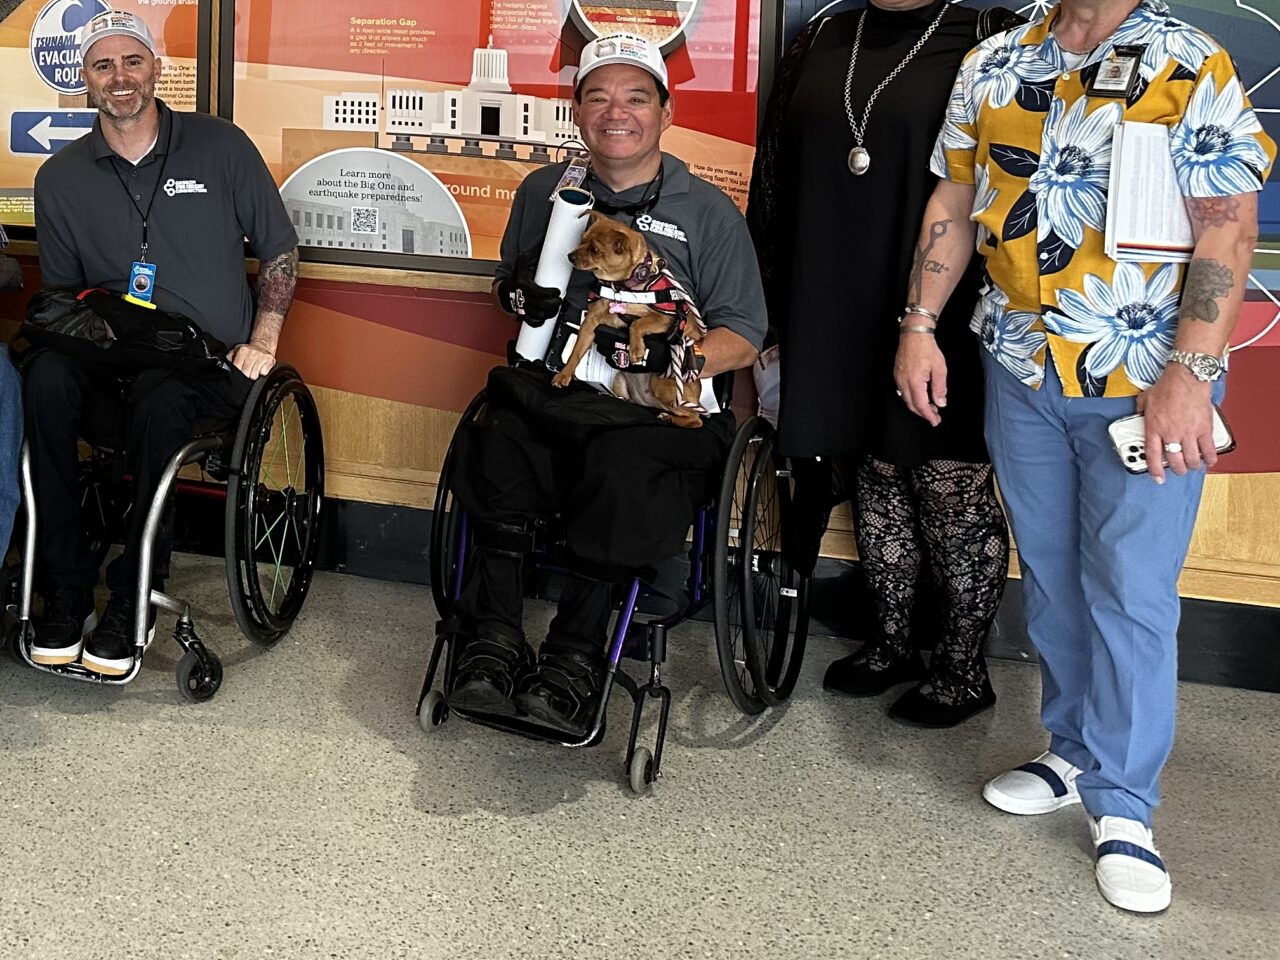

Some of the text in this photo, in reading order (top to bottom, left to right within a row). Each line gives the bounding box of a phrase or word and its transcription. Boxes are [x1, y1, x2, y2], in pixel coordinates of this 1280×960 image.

[350, 17, 416, 27] Separation Gap
[36, 35, 76, 47] TSUNAMI
[39, 49, 82, 65] EVACUA
[54, 67, 83, 82] ROU
[340, 169, 366, 178] Learn
[317, 179, 414, 191] about the Big One and
[445, 184, 490, 198] round
[309, 189, 423, 202] earthquake preparedness!
